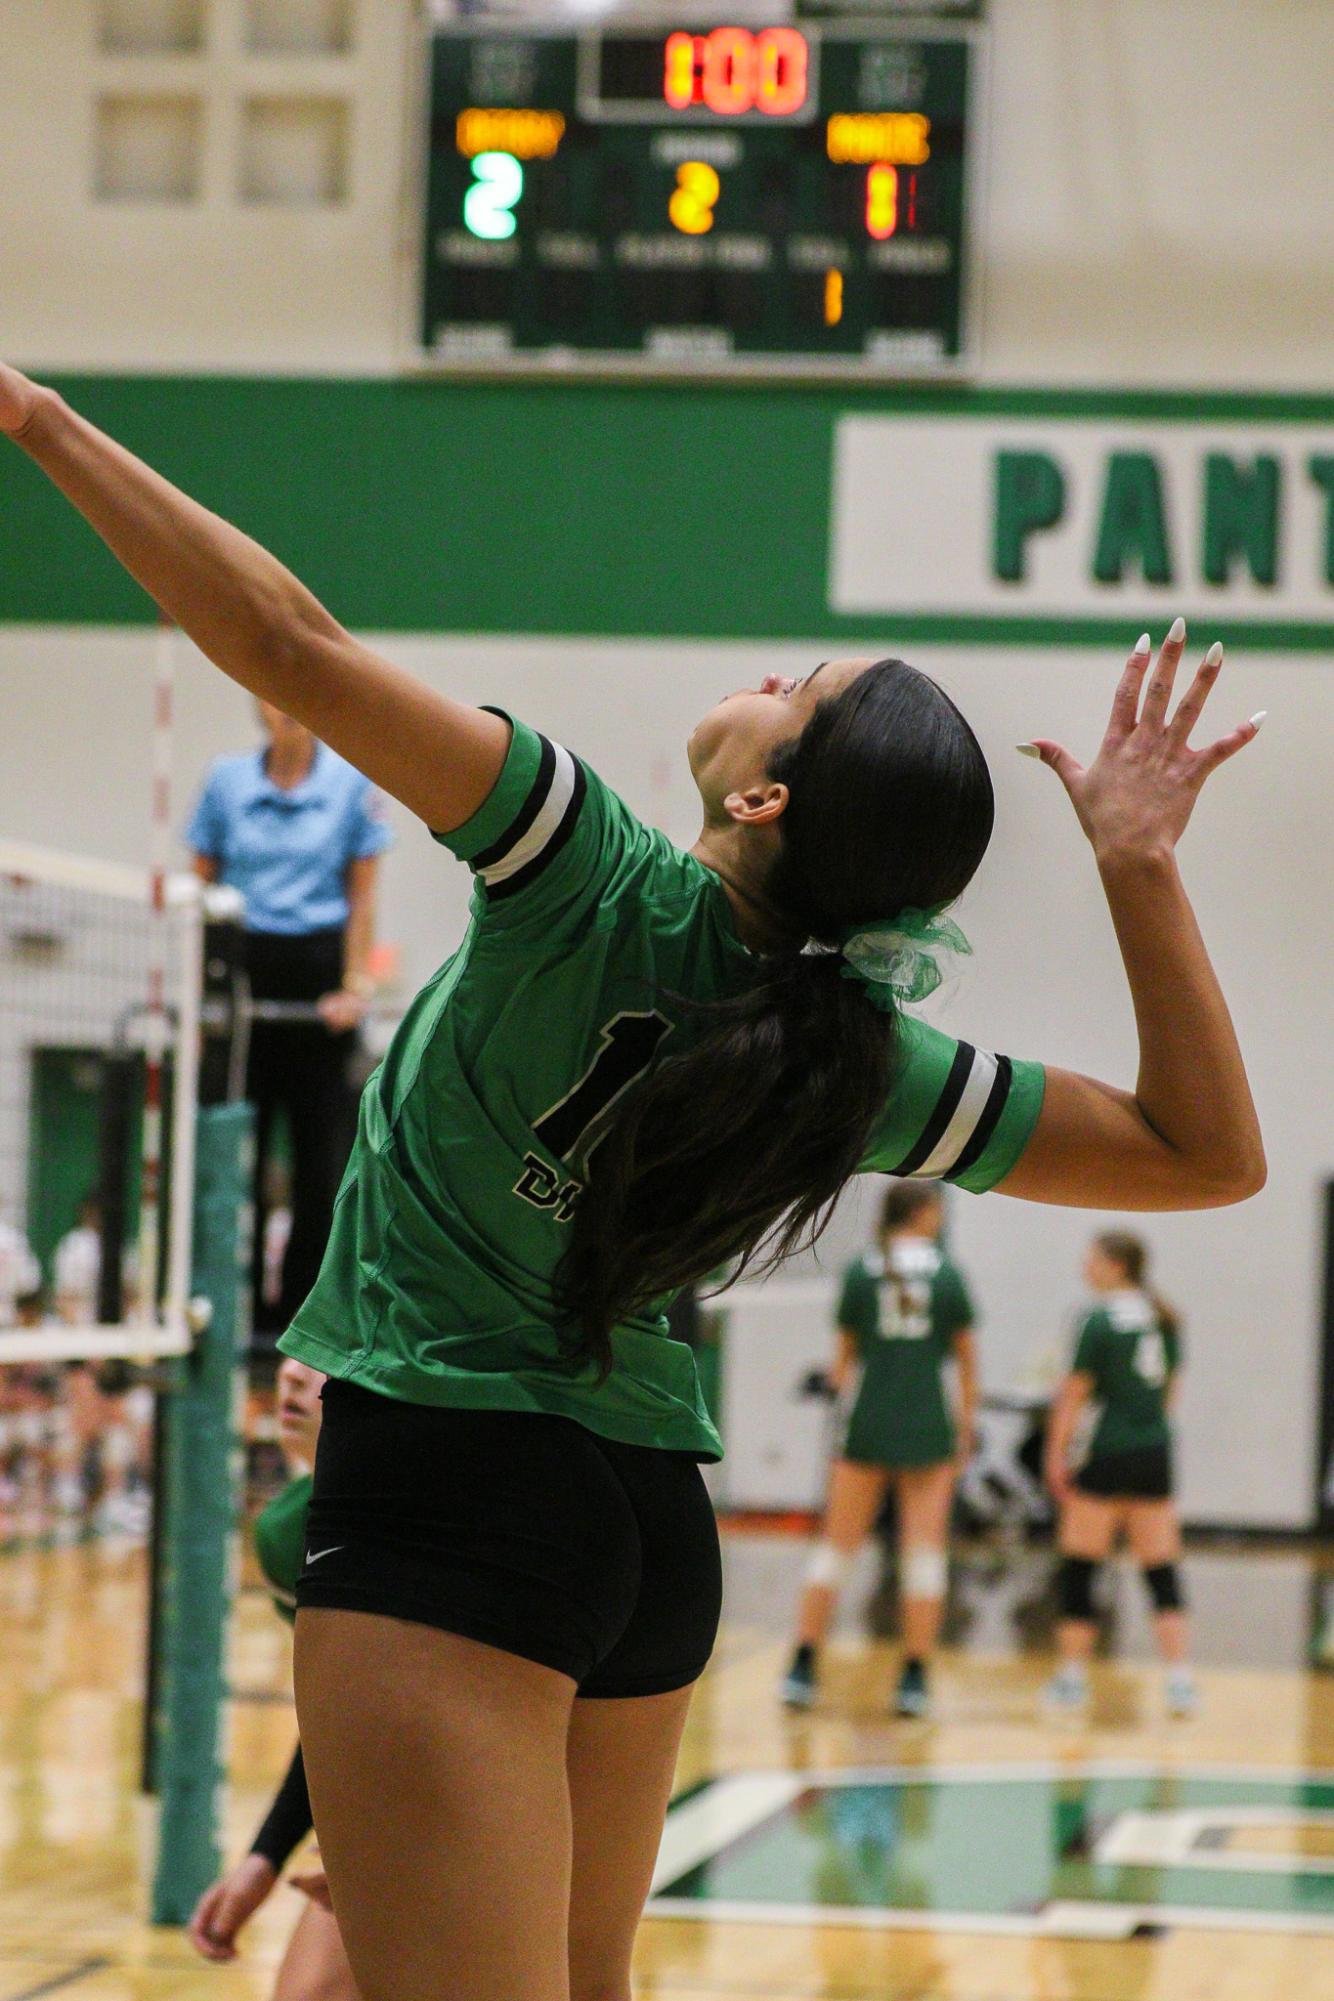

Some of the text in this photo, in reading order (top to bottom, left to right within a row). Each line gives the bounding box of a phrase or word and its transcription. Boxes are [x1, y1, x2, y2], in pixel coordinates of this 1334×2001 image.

[664, 26, 808, 115] 1:00
[463, 151, 524, 240] 2
[669, 161, 720, 235] 2
